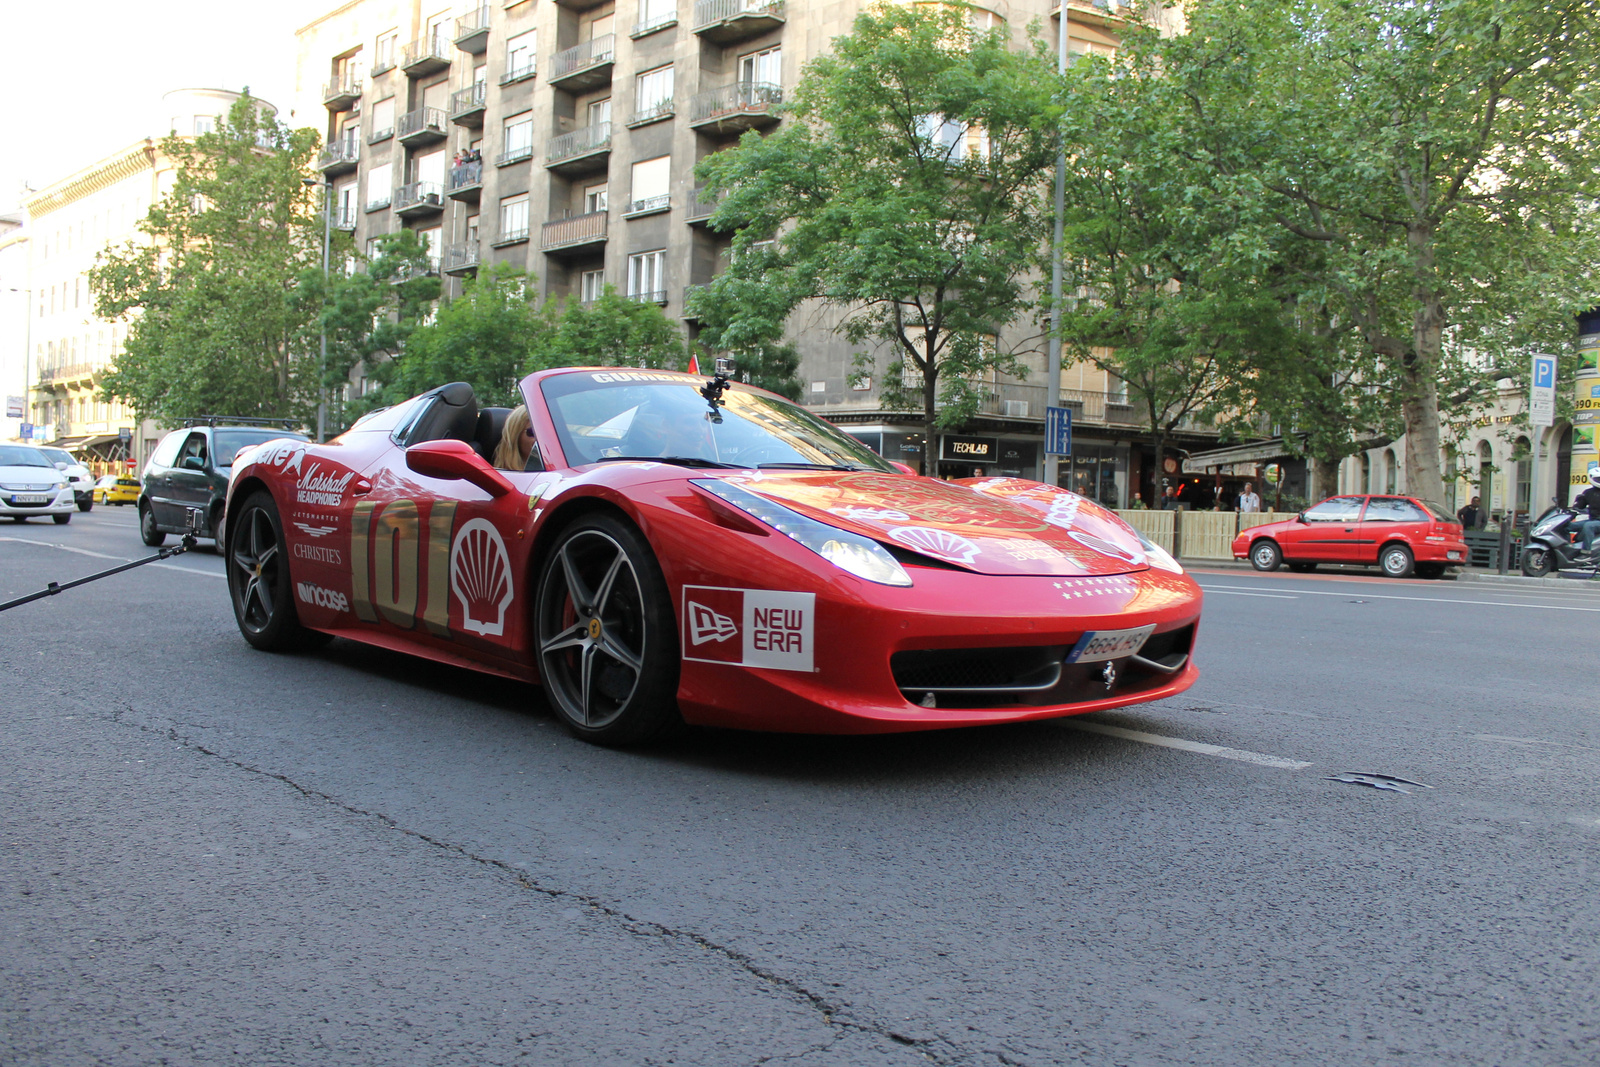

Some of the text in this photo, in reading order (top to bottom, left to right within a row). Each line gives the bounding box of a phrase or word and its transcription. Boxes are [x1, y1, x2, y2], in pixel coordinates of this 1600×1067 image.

[1538, 362, 1550, 384] P
[953, 442, 989, 454] TECHLAB
[297, 462, 355, 493] Marshall
[297, 490, 342, 506] HEADPHONES
[293, 512, 339, 521] JETSMARTER
[293, 543, 342, 565] CHRISTIE'S
[351, 499, 459, 642] 101
[754, 607, 803, 631] NEW
[754, 630, 803, 653] ERA
[1083, 636, 1125, 655] 8664
